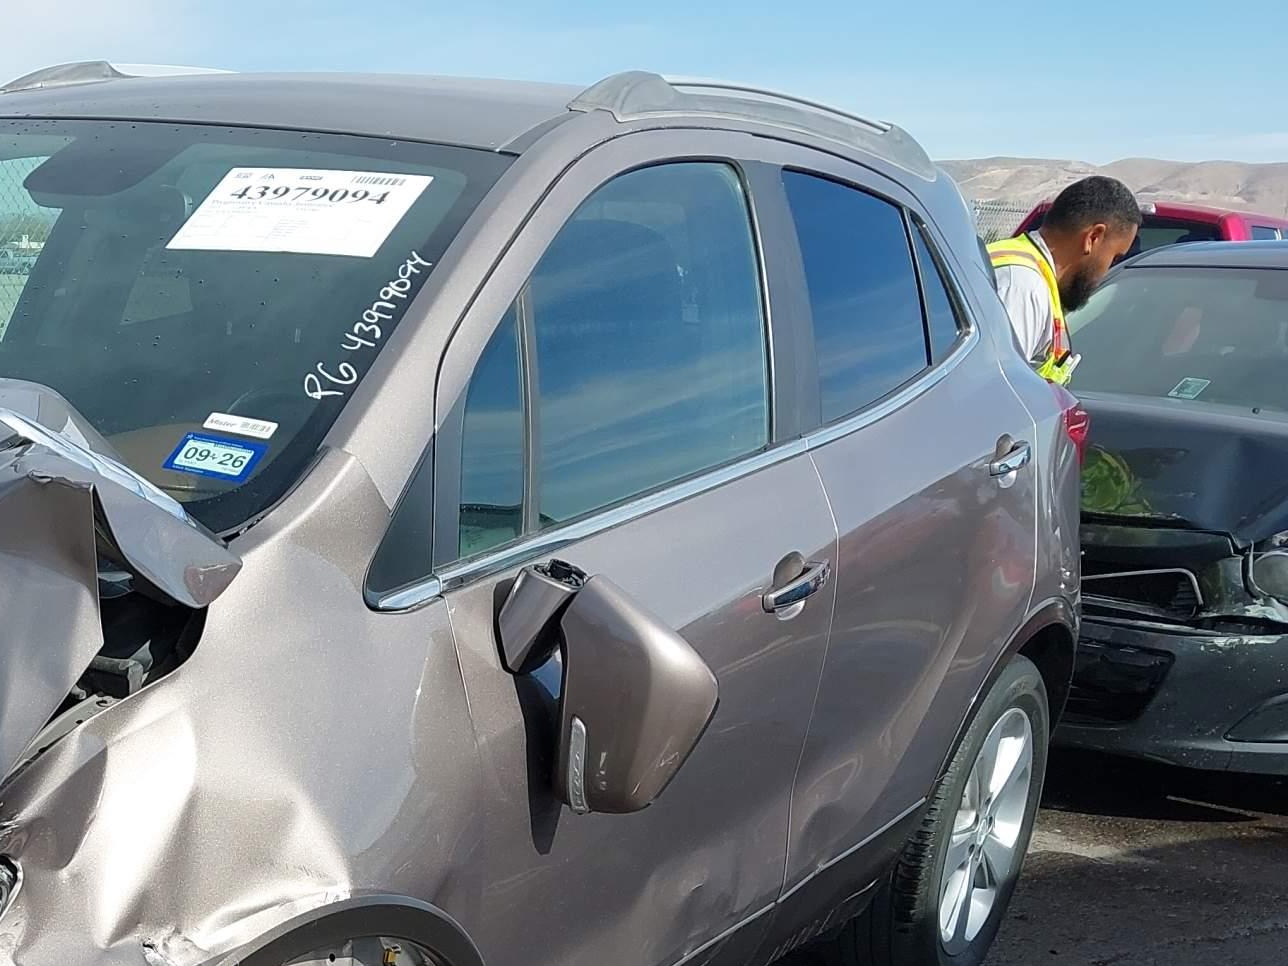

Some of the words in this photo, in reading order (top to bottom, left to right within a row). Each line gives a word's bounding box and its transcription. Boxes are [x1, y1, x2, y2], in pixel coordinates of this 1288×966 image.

[230, 185, 391, 205] 43979094
[341, 251, 433, 350] 43979094
[183, 446, 211, 462] 09
[217, 452, 247, 468] 26
